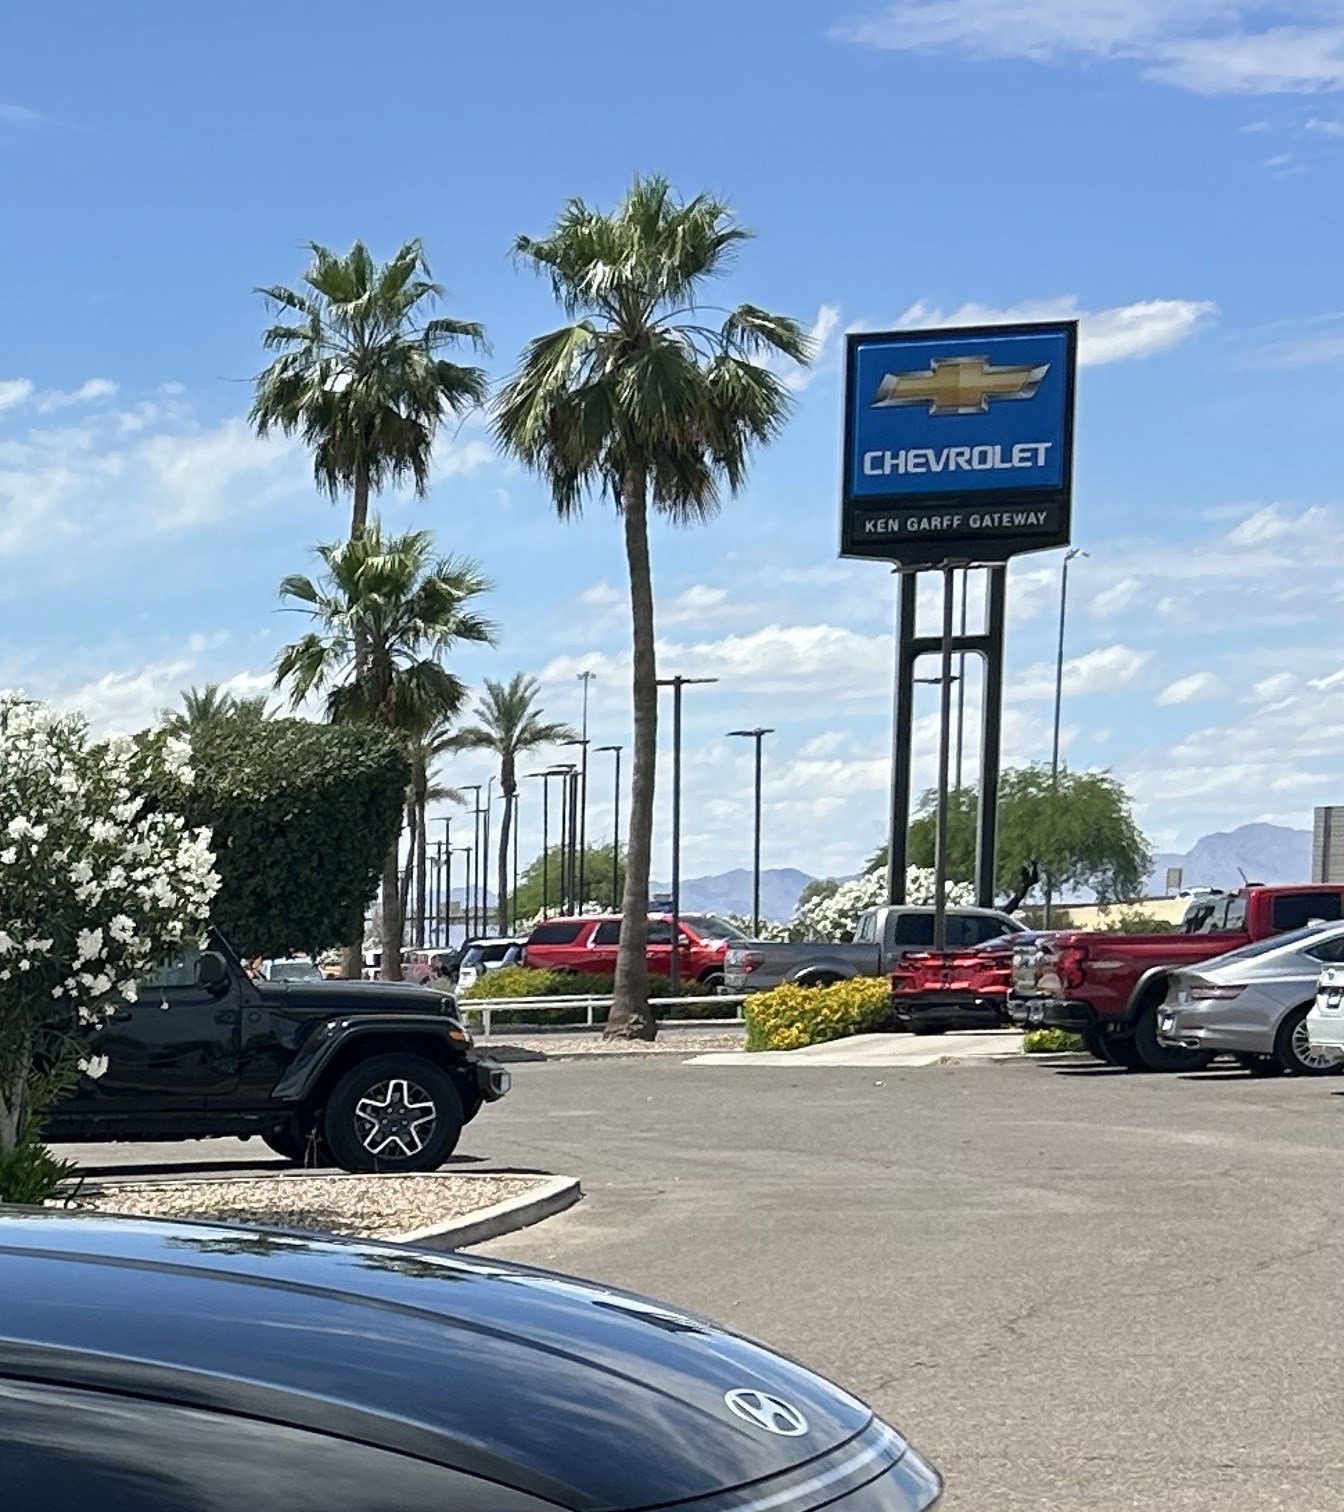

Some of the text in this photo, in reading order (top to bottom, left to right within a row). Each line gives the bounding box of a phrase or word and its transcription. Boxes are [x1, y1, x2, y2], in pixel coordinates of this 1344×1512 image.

[863, 442, 1052, 475] CHEVROLET
[865, 510, 1047, 533] KEN GARFF GATEWAY
